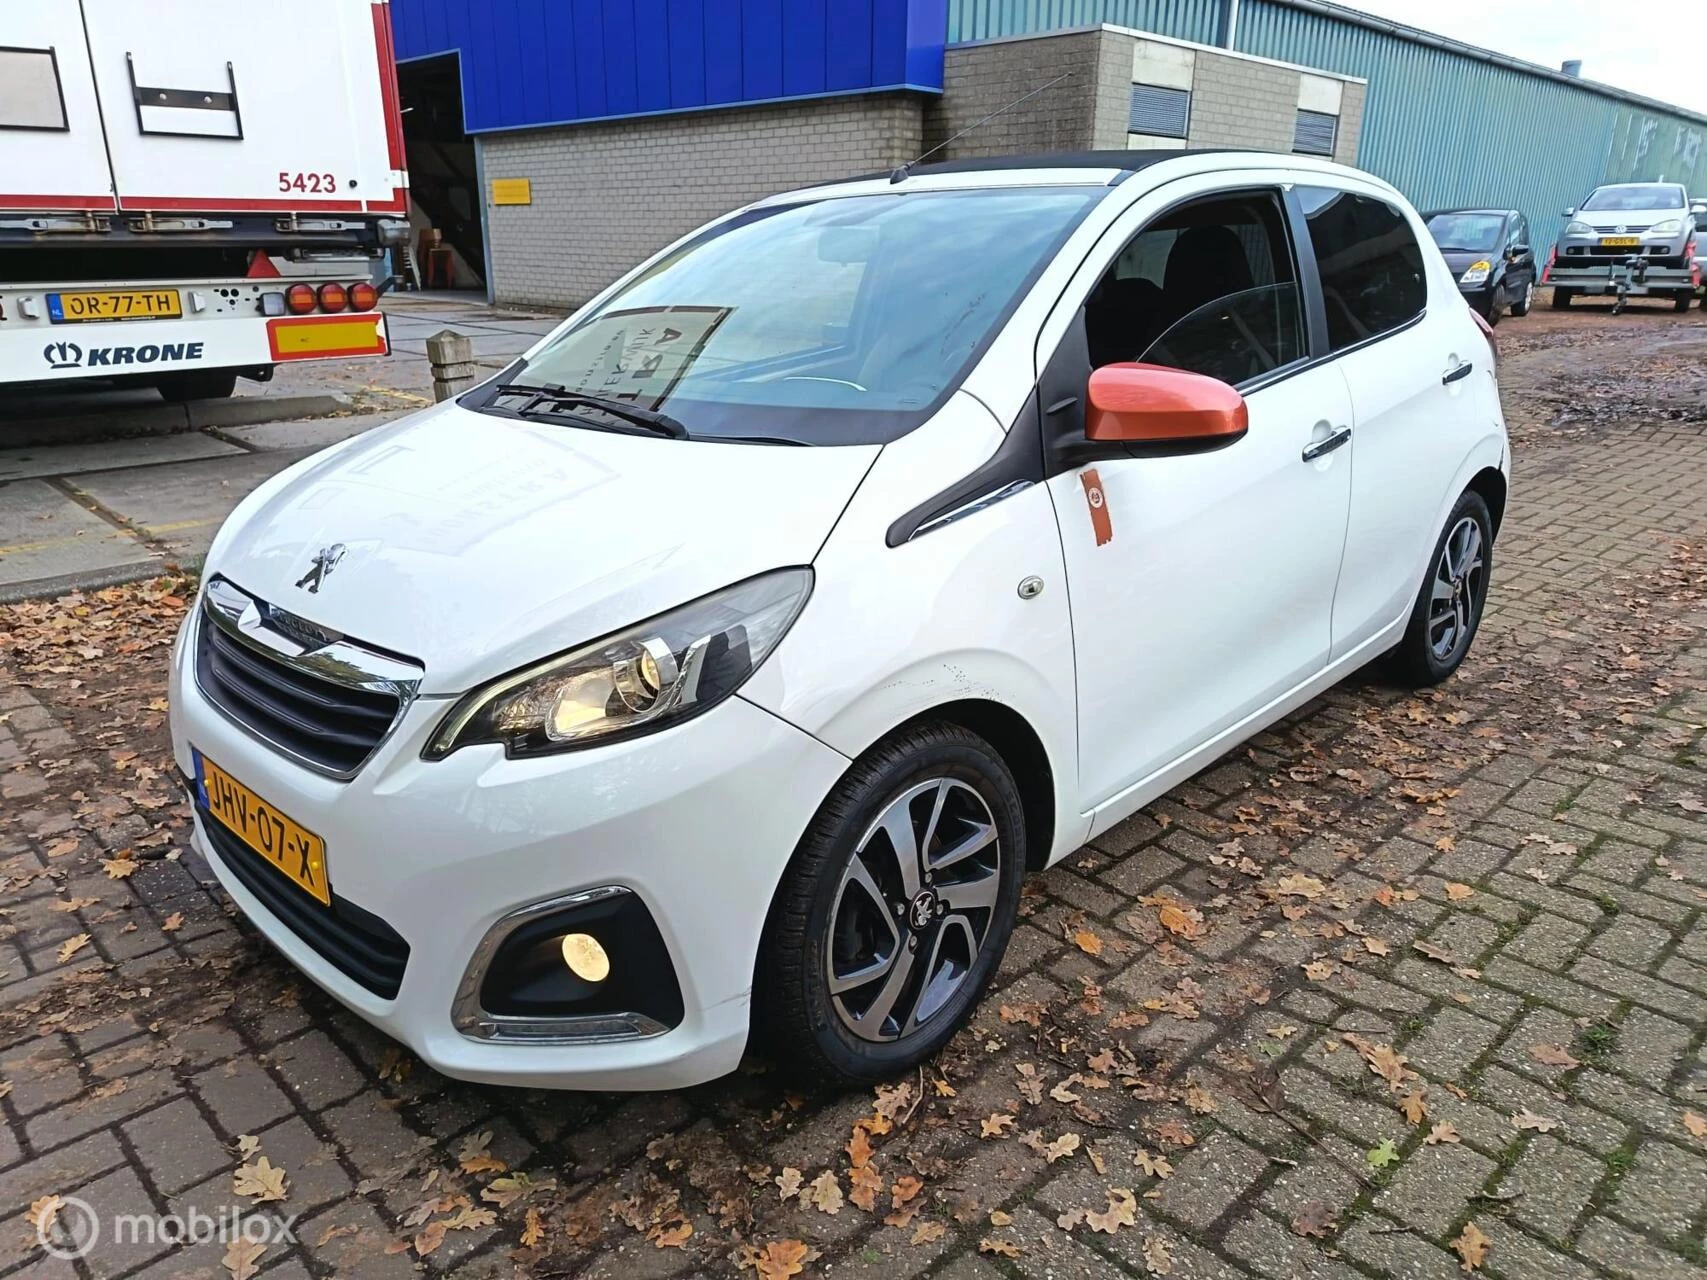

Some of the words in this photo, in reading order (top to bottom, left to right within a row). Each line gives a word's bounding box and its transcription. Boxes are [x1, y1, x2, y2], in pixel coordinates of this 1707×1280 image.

[278, 172, 337, 193] 5423
[70, 294, 171, 315] OR-77-TH
[88, 342, 204, 367] KRONE
[213, 771, 315, 887] JHV-07-X
